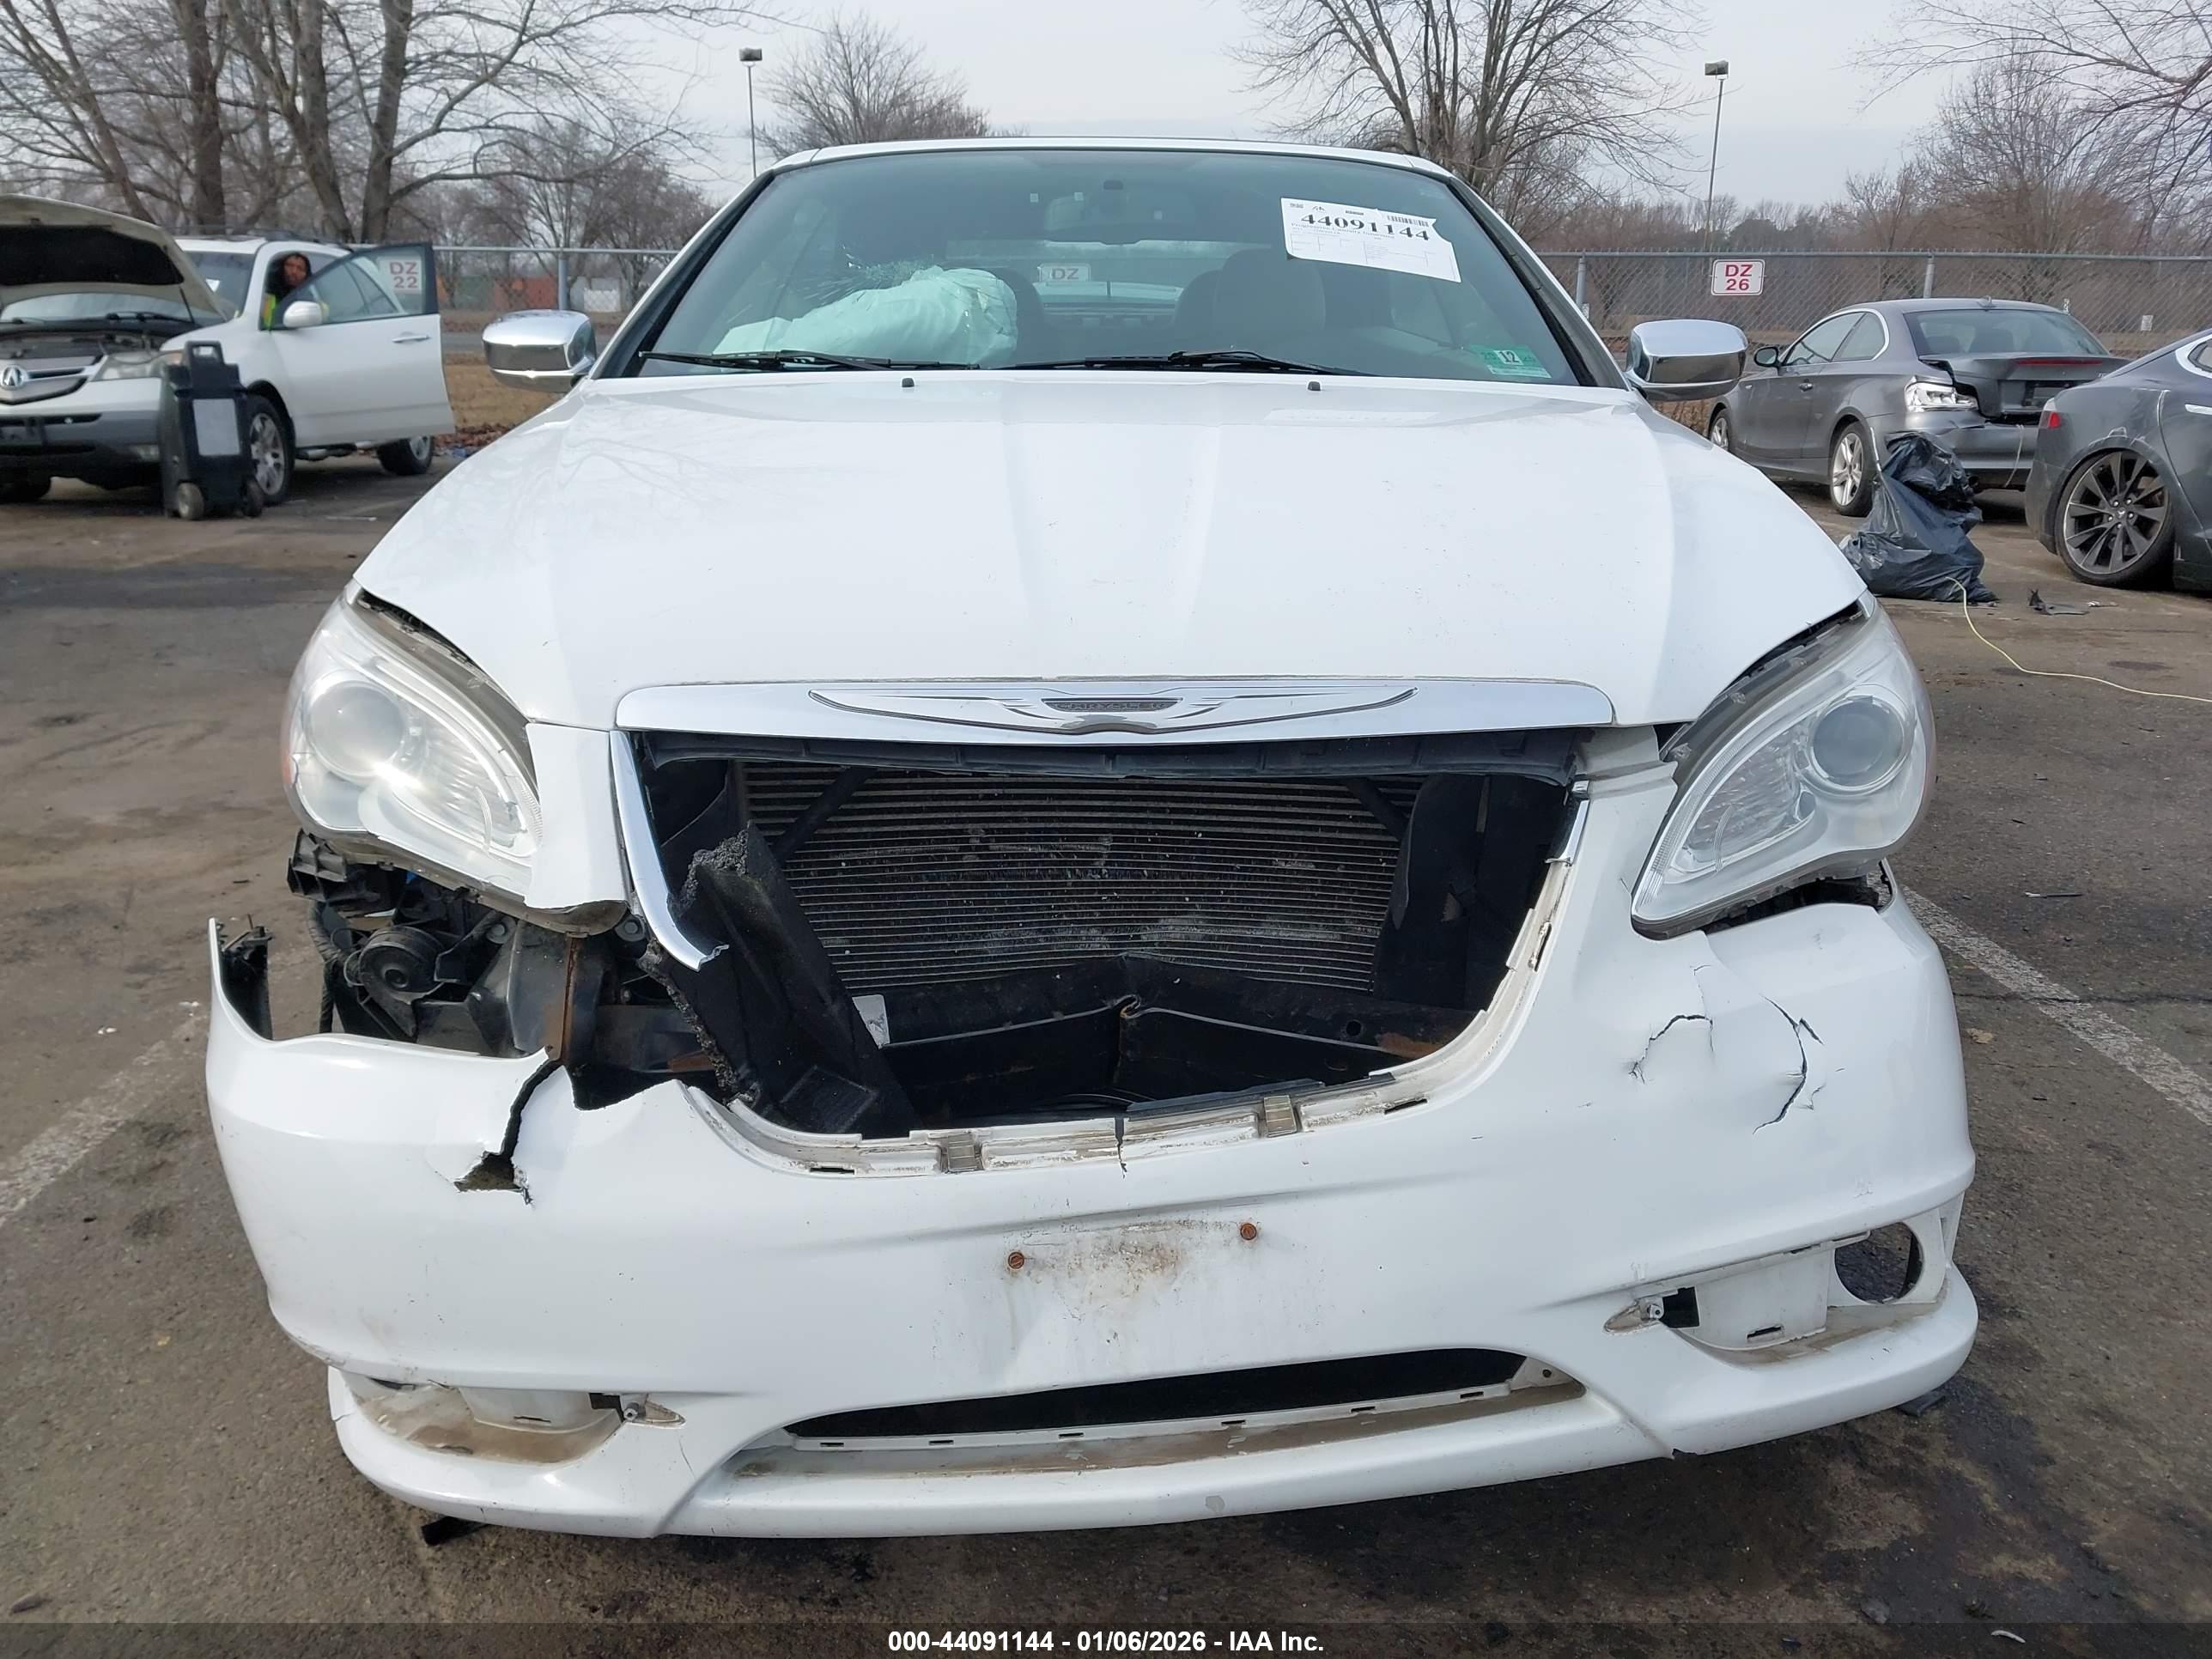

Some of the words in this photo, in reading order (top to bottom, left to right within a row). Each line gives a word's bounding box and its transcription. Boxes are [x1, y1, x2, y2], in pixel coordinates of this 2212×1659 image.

[1301, 214, 1430, 241] 44091144
[390, 261, 418, 275] DZ
[1052, 268, 1079, 280] DZ
[1725, 264, 1753, 276] DZ
[394, 276, 417, 289] 22
[1726, 279, 1749, 290] 26
[1499, 351, 1520, 362] 12
